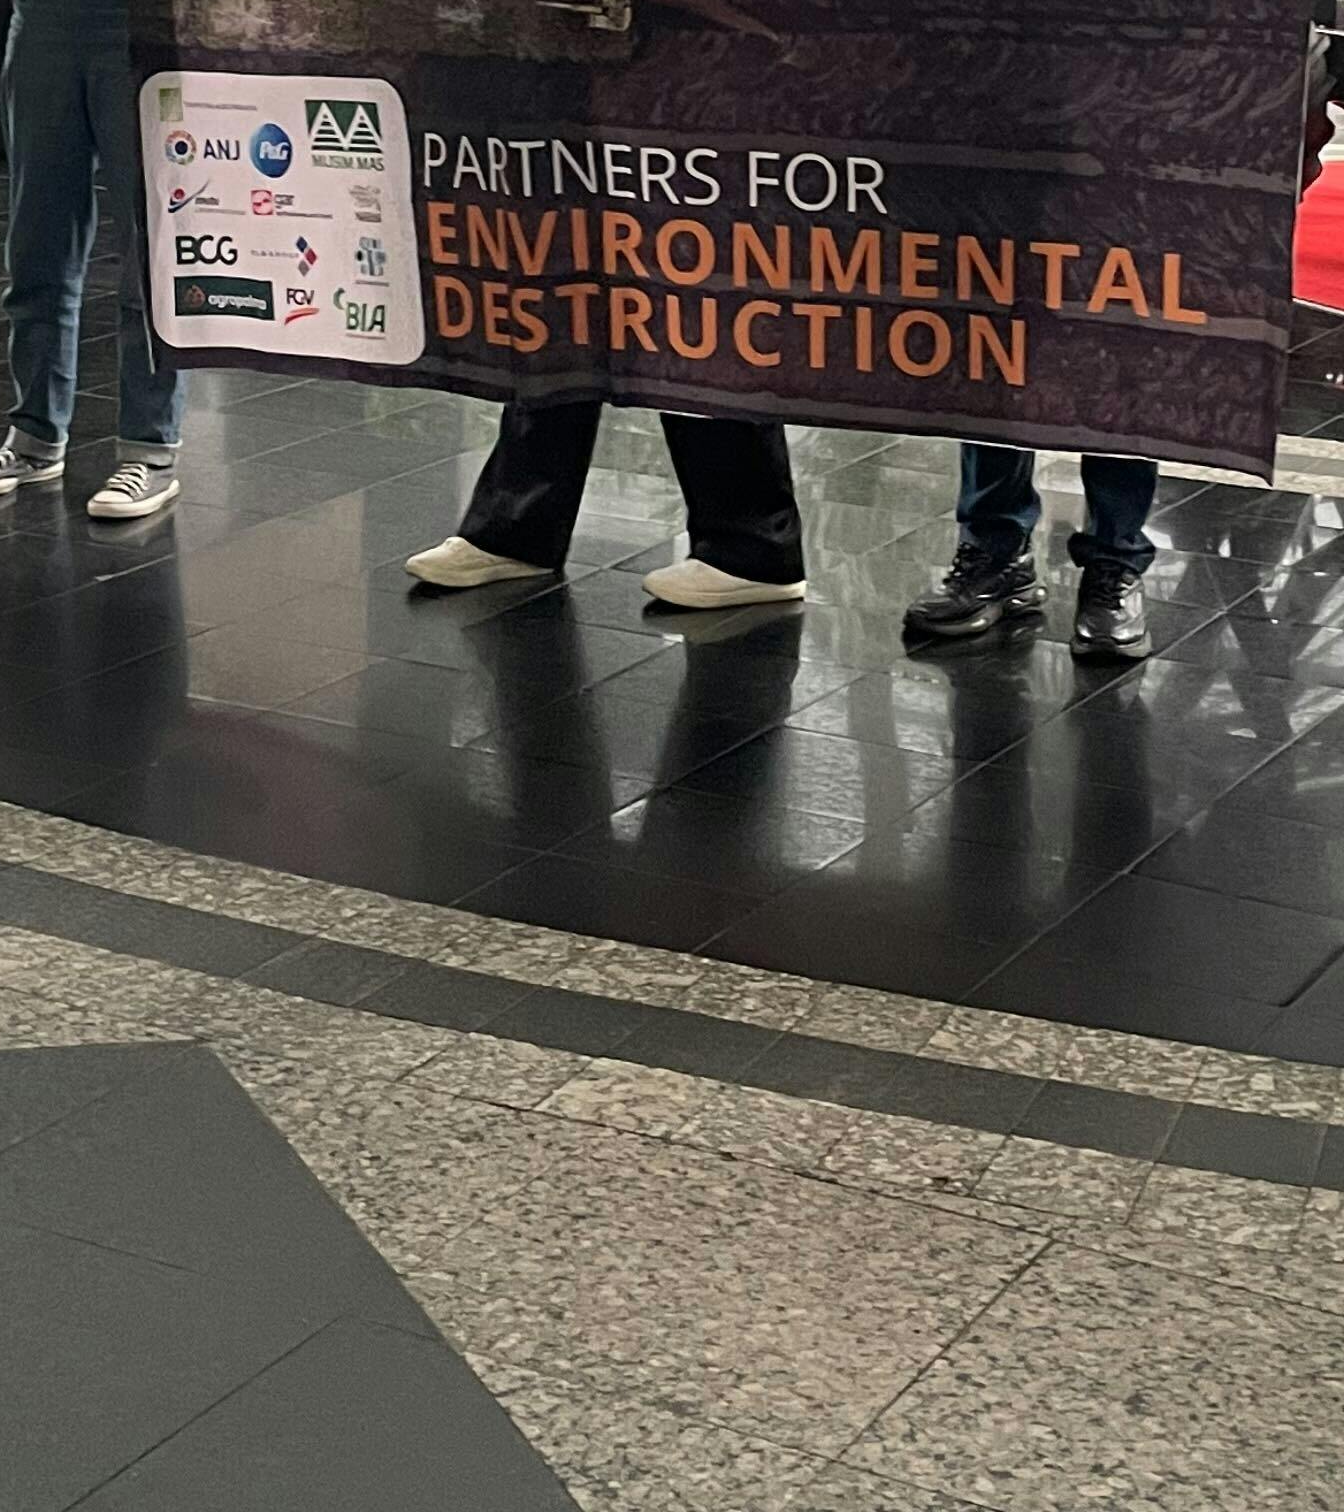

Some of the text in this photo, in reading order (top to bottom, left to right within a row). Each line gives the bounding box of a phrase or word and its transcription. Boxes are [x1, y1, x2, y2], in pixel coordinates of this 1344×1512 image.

[203, 138, 241, 161] ANJ
[356, 155, 385, 172] MAS
[422, 132, 889, 215] PARTNERS FOR
[175, 234, 239, 266] BCG
[426, 200, 1207, 325] ENVIRONMENTAL
[286, 287, 315, 306] FGV
[345, 301, 387, 333] BIA
[432, 274, 1028, 387] DESTRUCTION
